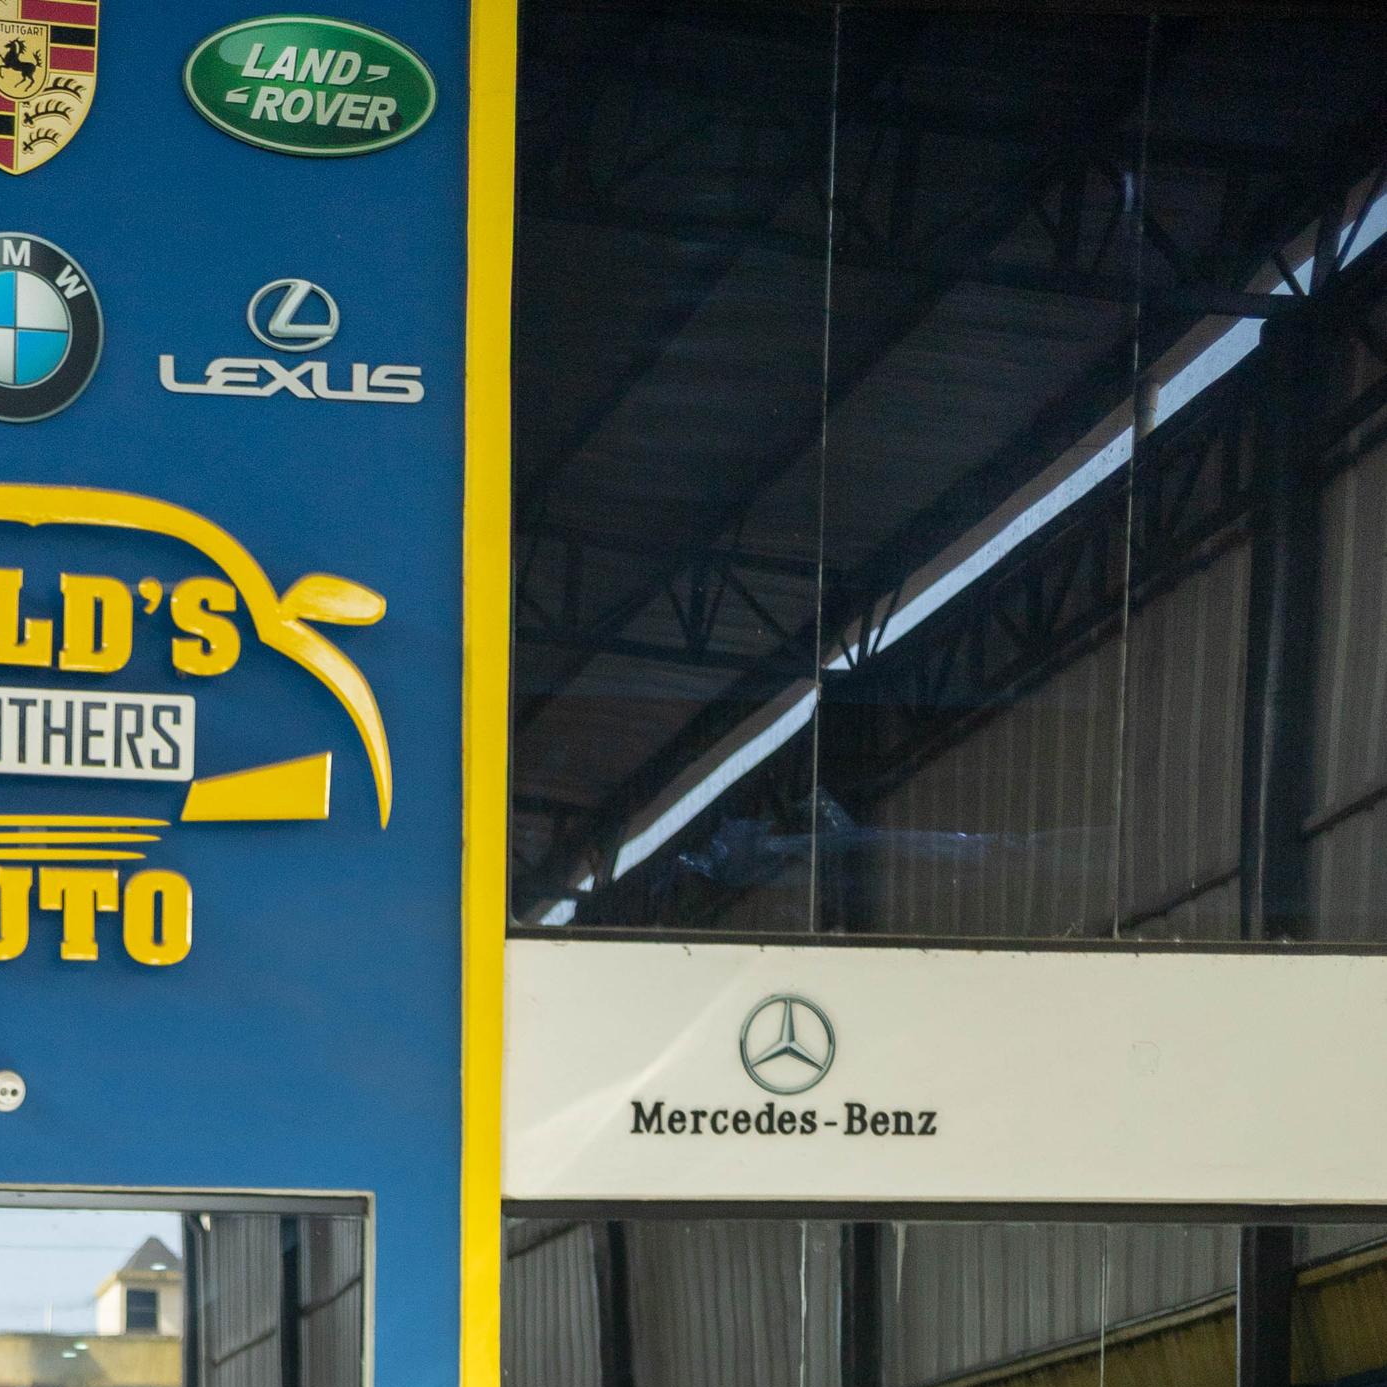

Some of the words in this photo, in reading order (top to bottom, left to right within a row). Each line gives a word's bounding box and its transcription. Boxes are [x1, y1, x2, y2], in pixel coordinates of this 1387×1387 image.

[241, 43, 362, 86] LAND
[250, 86, 397, 131] ROVER
[159, 354, 425, 404] LEXUS
[629, 1101, 939, 1137] Mercedes-Benz
